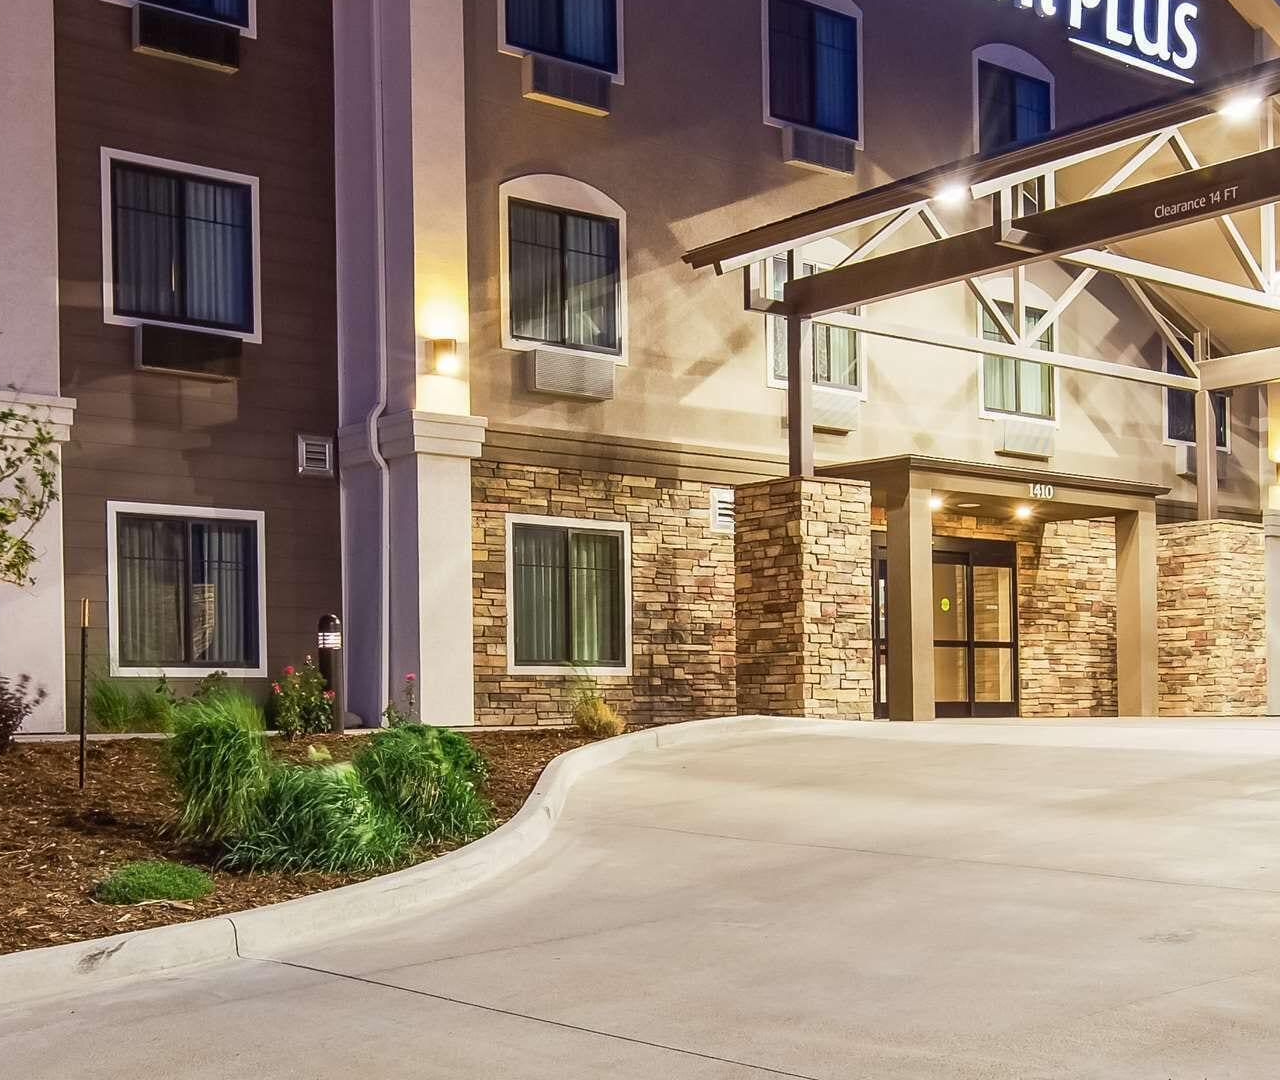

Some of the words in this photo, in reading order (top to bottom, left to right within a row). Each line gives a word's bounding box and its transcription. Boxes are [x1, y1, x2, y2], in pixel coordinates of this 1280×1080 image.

[1154, 196, 1206, 218] Clearance
[1209, 191, 1221, 204] 14
[1224, 186, 1238, 200] FT
[1028, 483, 1054, 499] 1410
